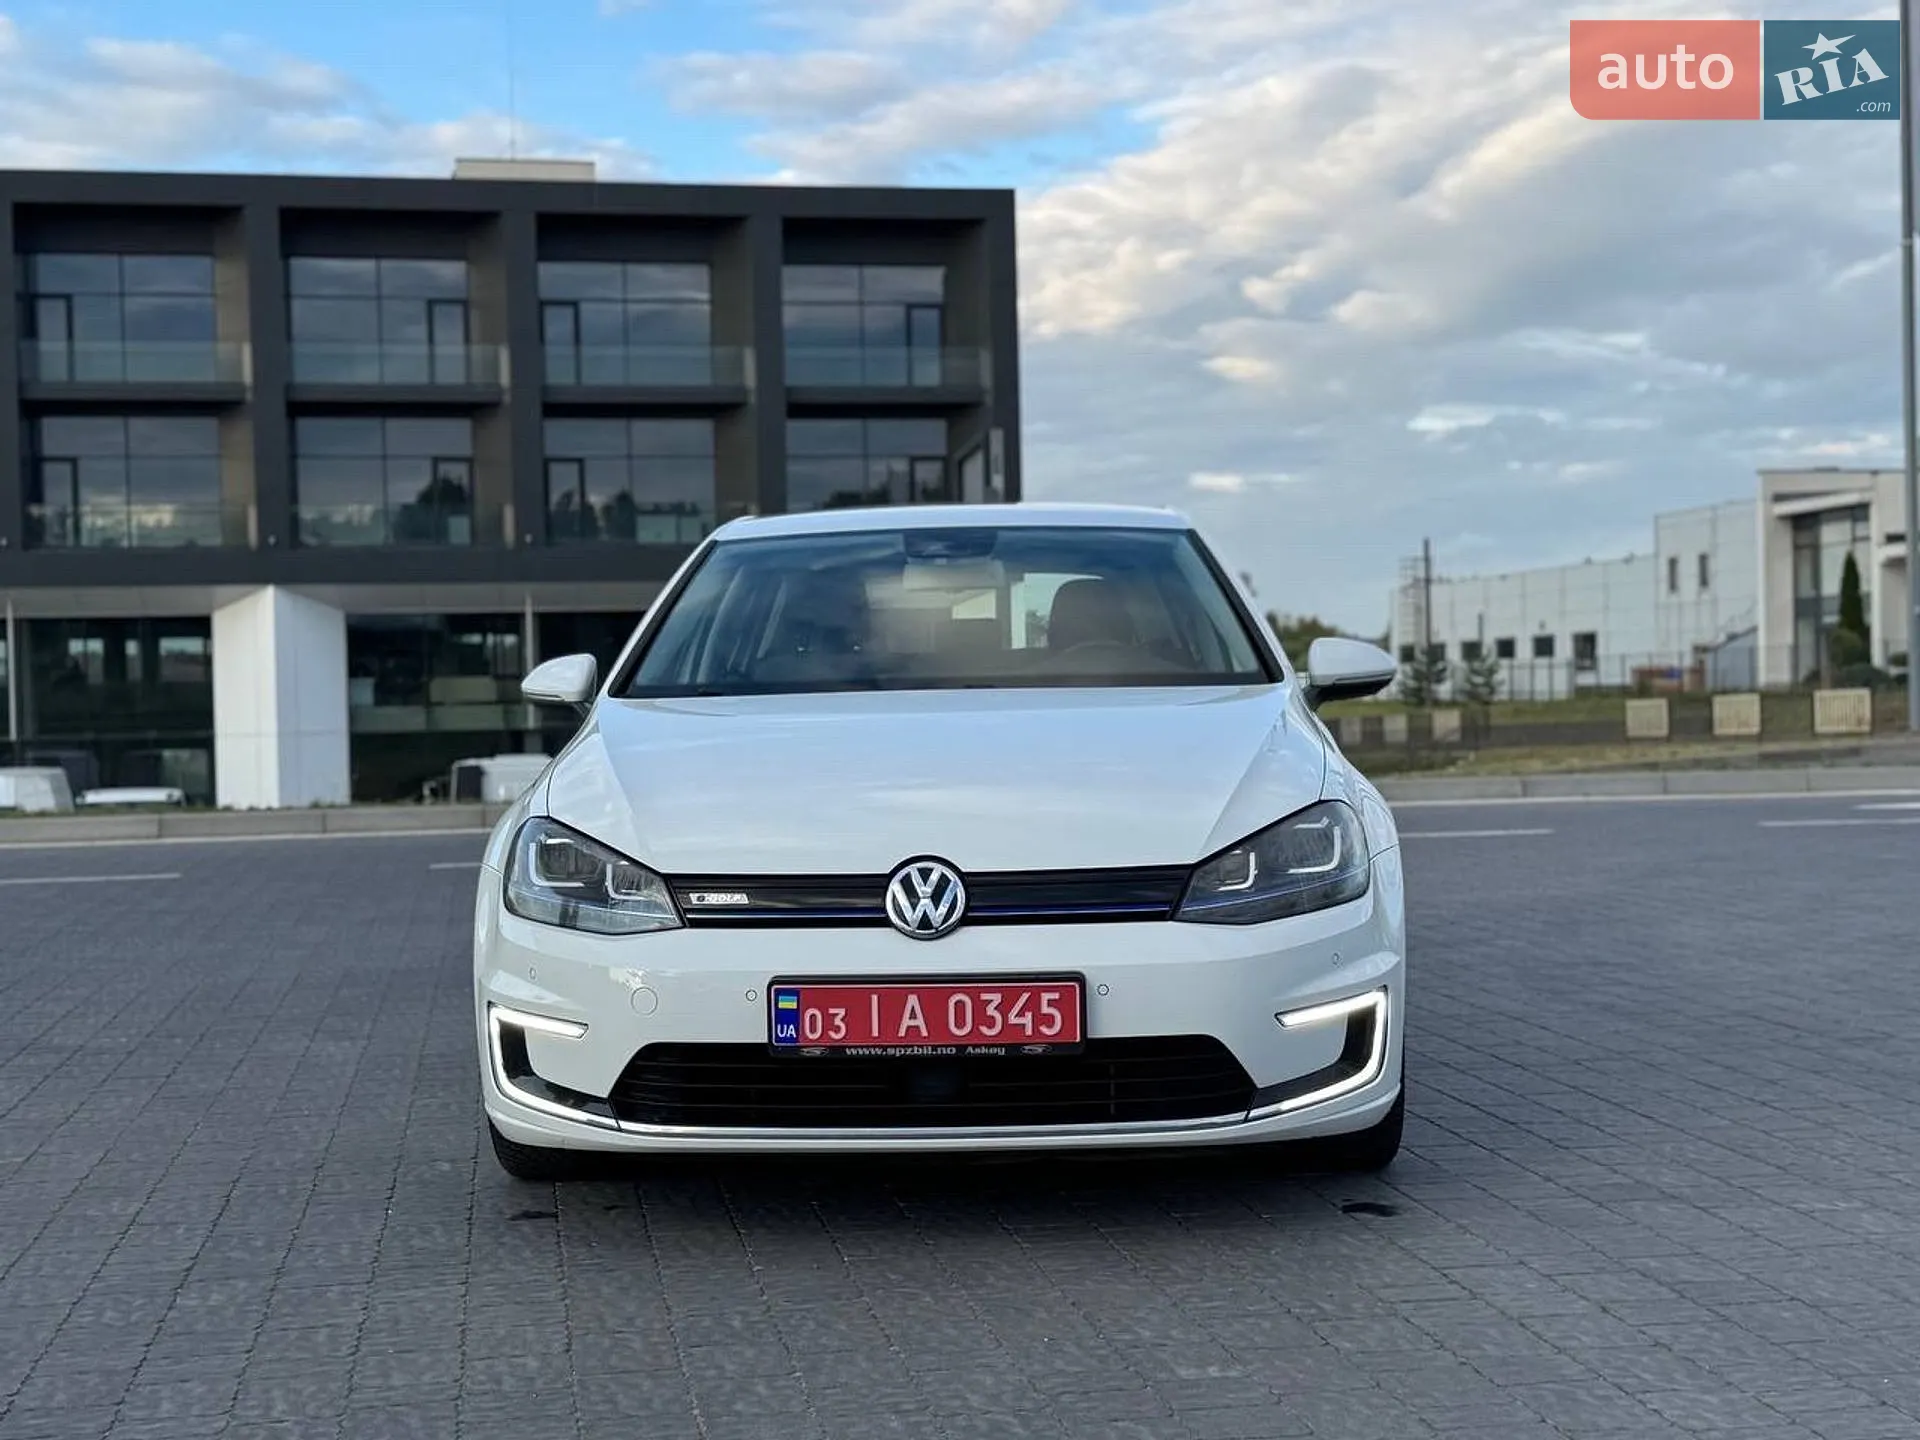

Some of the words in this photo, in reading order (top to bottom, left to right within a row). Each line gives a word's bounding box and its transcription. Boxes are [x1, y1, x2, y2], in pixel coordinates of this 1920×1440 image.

[776, 1023, 797, 1039] UA
[803, 1007, 848, 1041] 03
[947, 992, 1064, 1038] 0345
